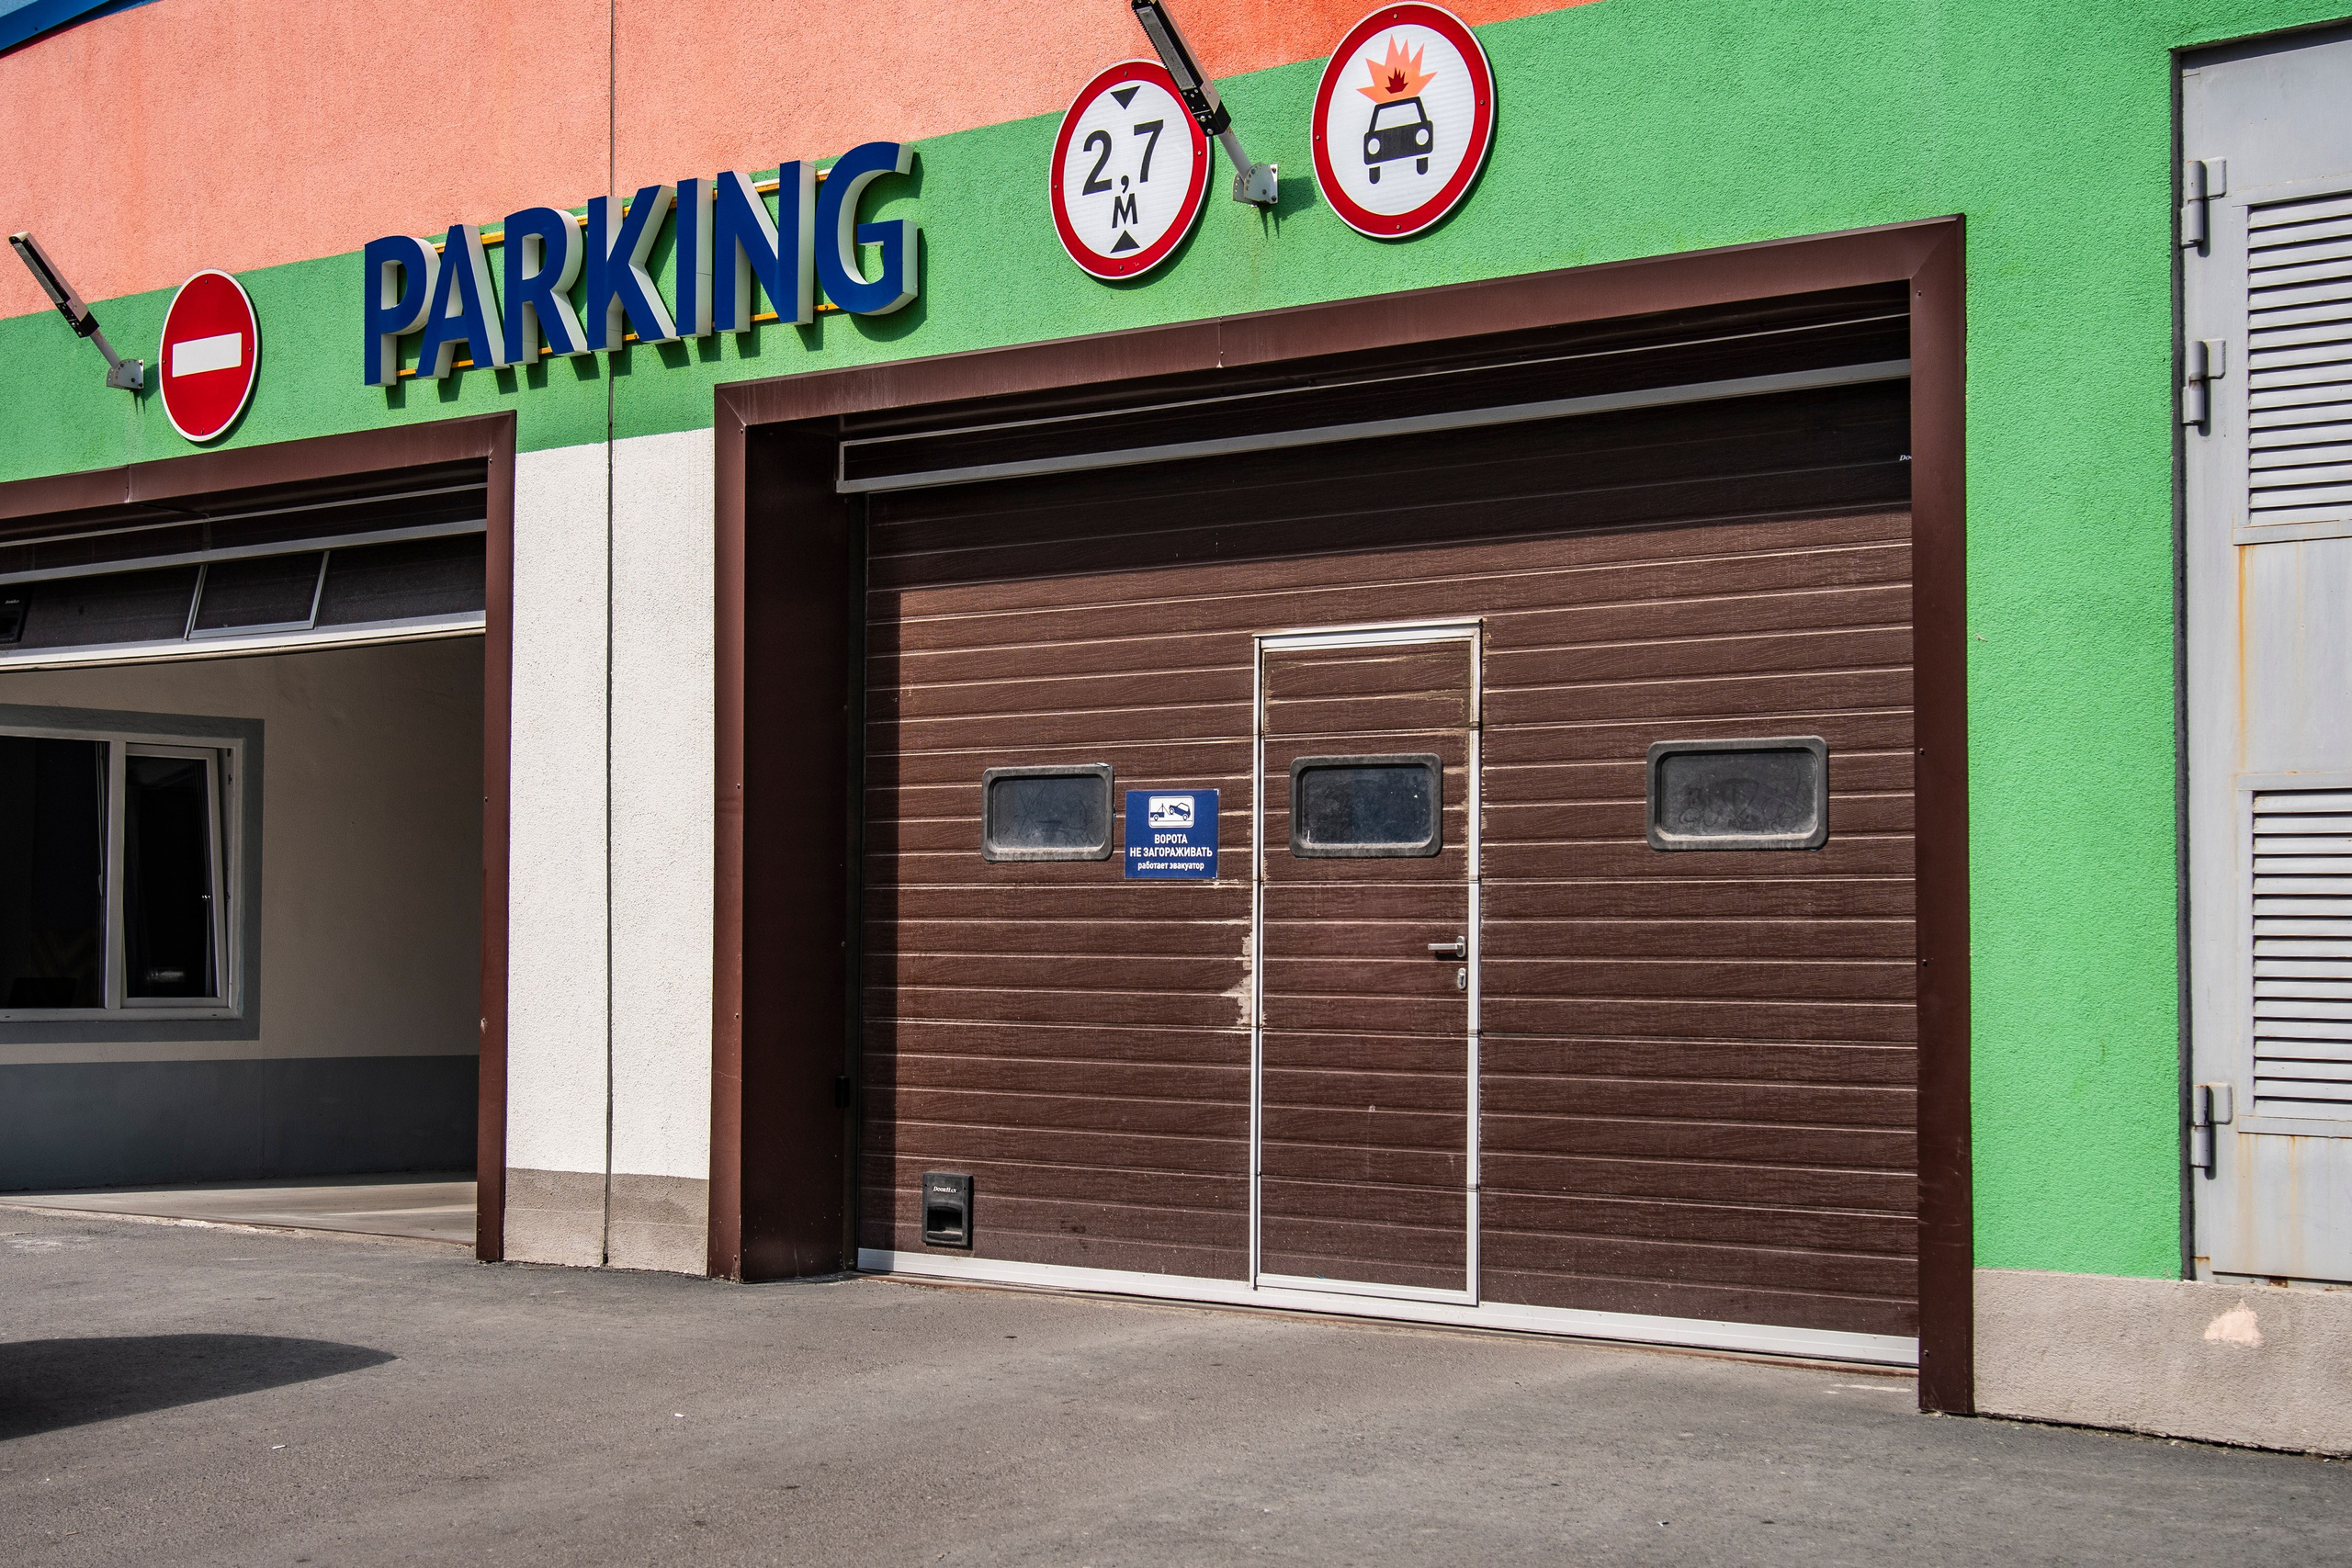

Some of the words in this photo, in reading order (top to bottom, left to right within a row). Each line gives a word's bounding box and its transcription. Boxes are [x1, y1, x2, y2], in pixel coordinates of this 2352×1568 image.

[1082, 119, 1164, 196] 2,7
[364, 141, 918, 387] PARKING
[1154, 834, 1188, 844] ВОРОТА
[1130, 847, 1142, 857] НЕ
[1143, 846, 1213, 857] ЗАГОРАЖИВАТЬ
[1137, 861, 1169, 872] работает
[1169, 862, 1204, 872] эвакуатор
